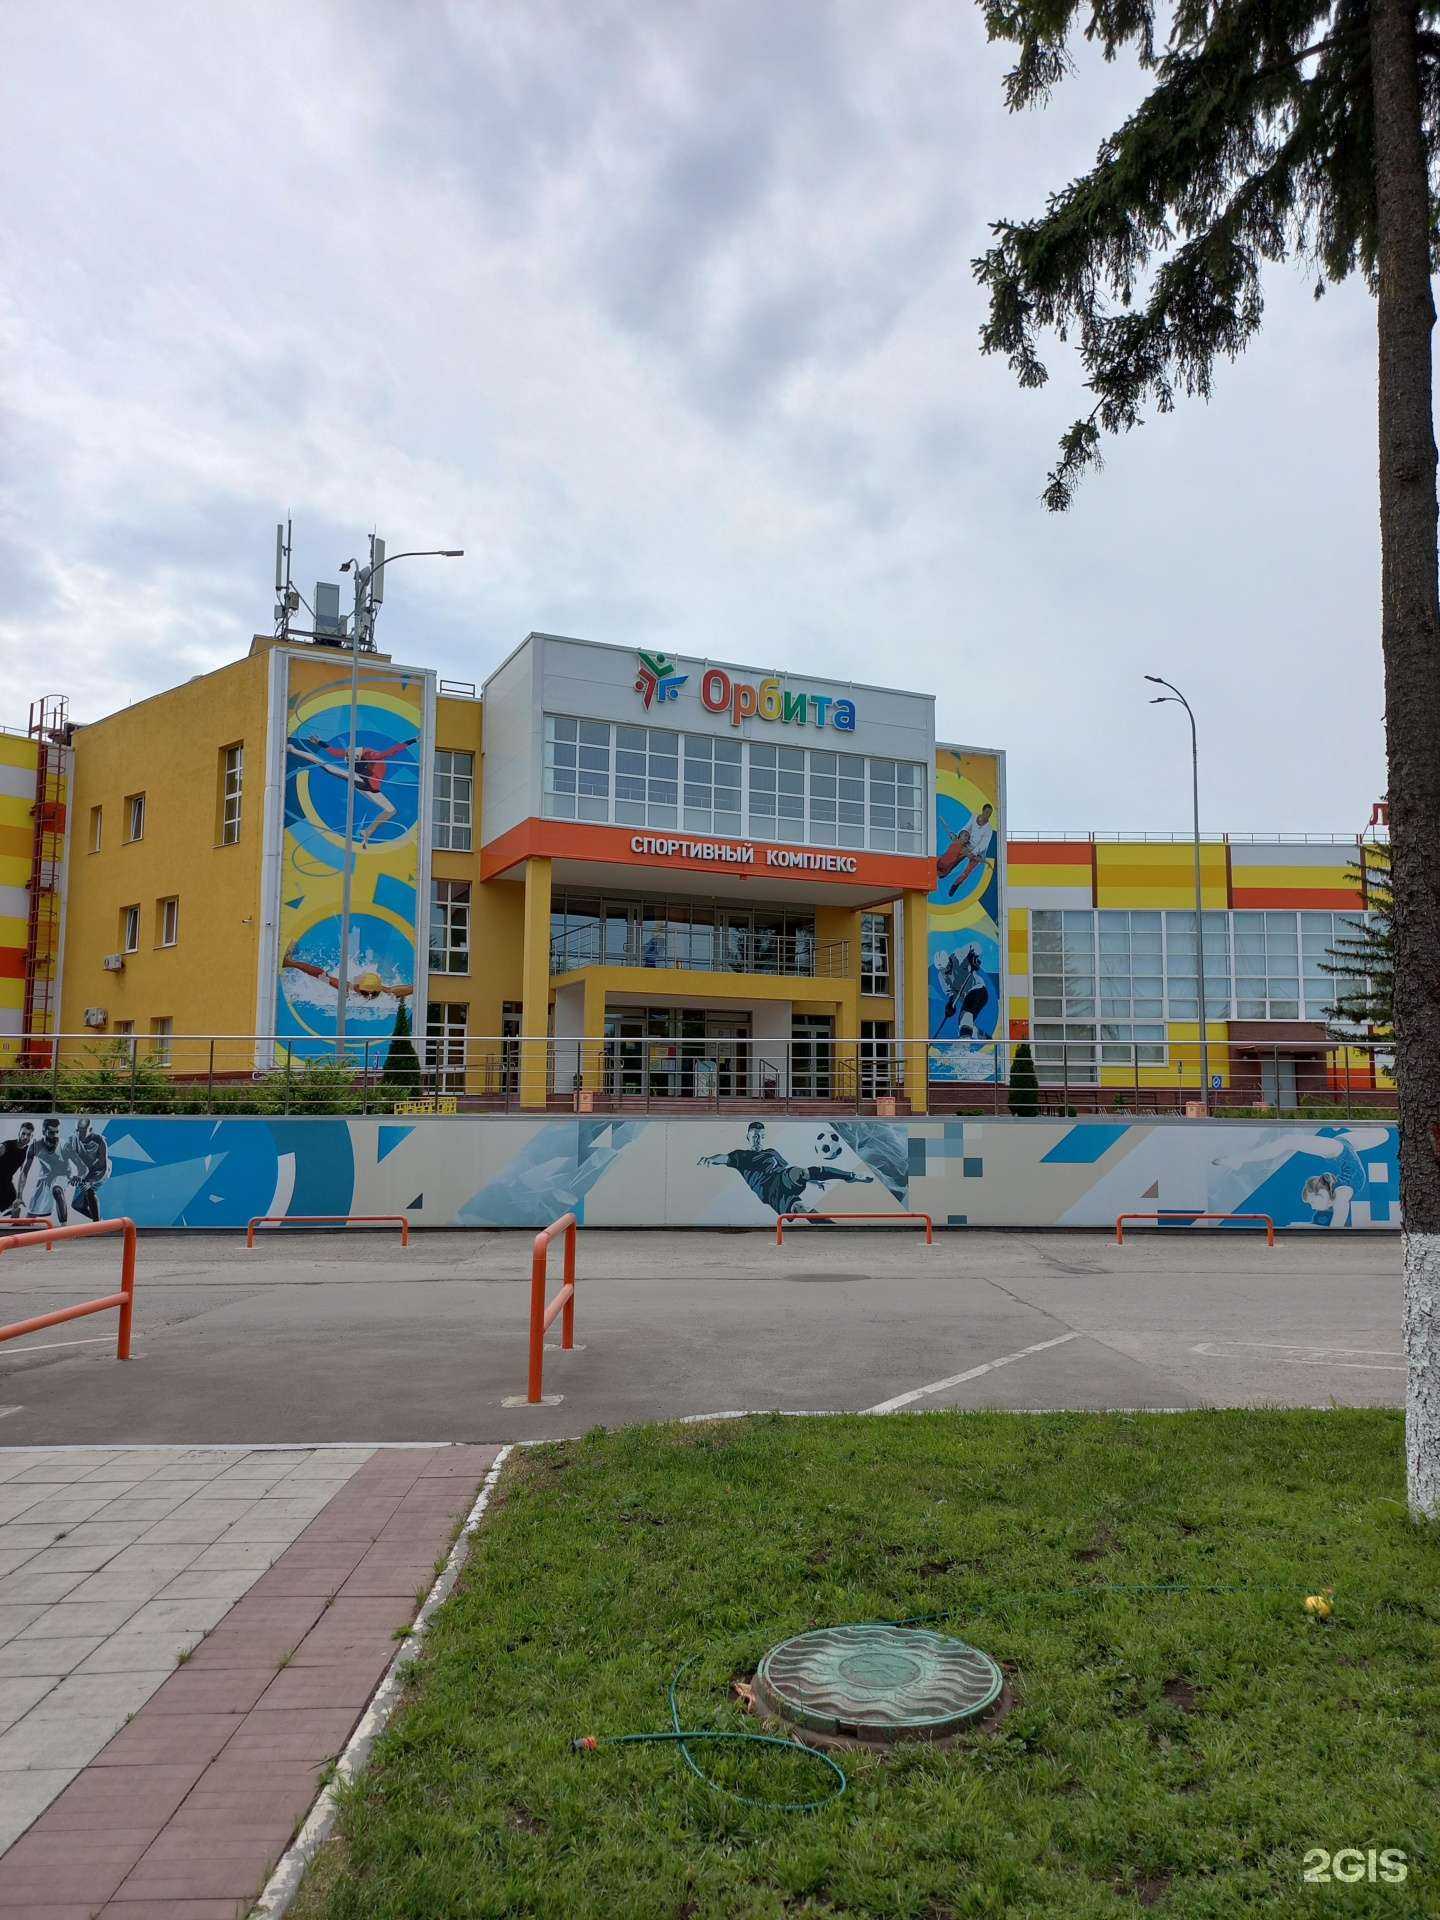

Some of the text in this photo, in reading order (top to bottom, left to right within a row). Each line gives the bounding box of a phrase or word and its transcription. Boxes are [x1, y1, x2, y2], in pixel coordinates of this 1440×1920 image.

[701, 668, 857, 732] Орбита
[631, 836, 857, 873] СПОРТИВНЫЙ КОМПЛЕКС
